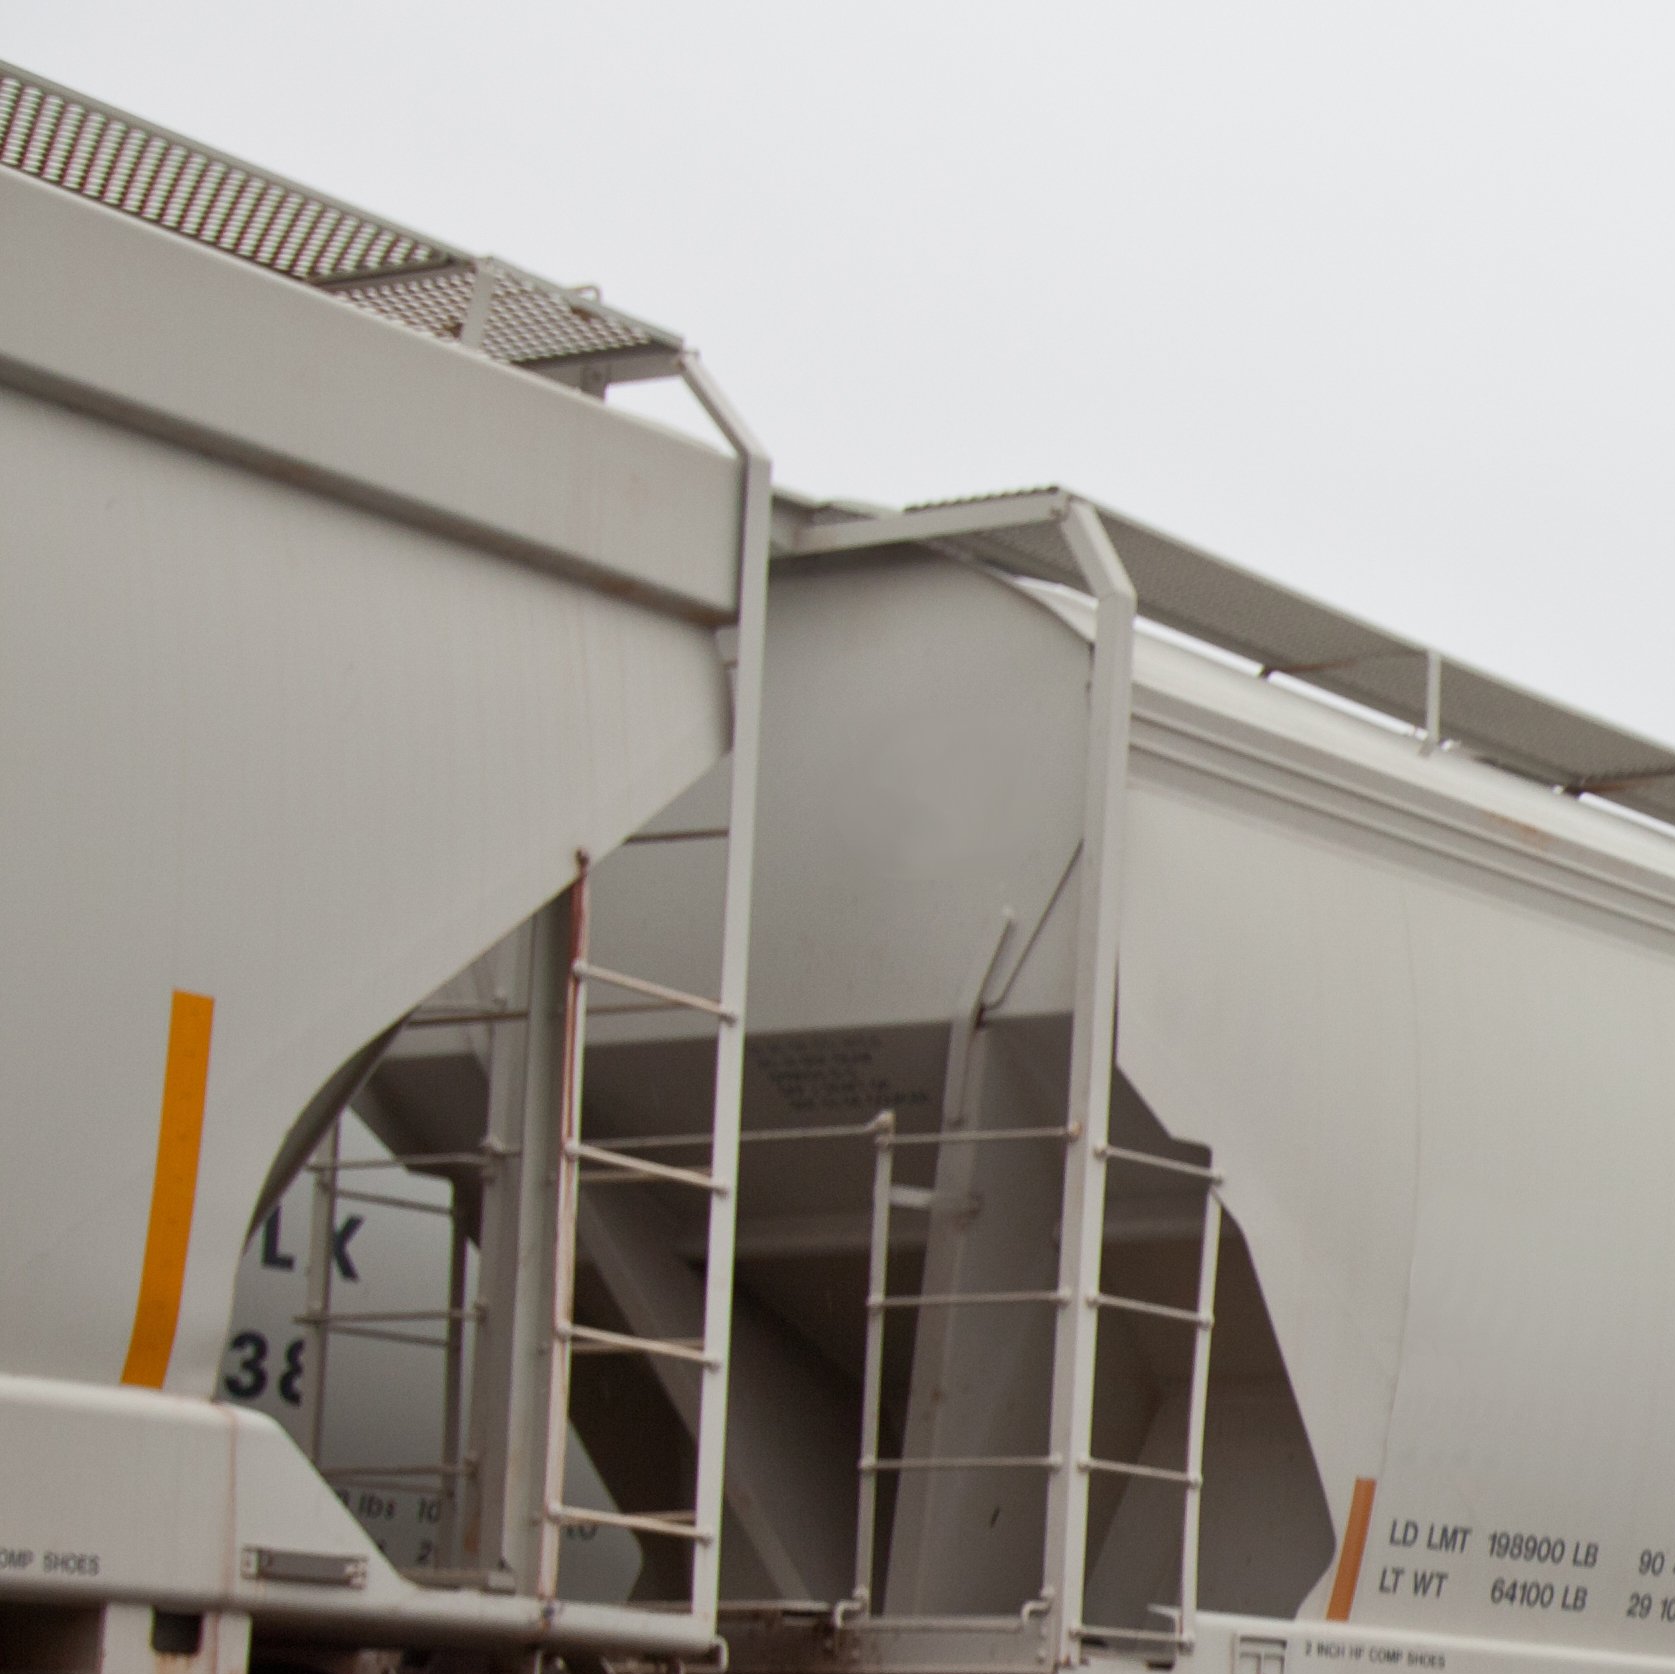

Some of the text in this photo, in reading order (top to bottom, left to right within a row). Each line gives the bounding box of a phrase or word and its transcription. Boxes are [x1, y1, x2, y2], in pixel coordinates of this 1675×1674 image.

[1389, 1518, 1419, 1547] LD
[1426, 1523, 1473, 1554] LMT
[1488, 1529, 1566, 1564] 198900
[1572, 1540, 1600, 1568] LB
[1639, 1548, 1665, 1577] 90
[1379, 1565, 1405, 1594] LT
[1413, 1568, 1449, 1599] WT
[1490, 1576, 1554, 1609] 64100
[1560, 1584, 1588, 1612] LB
[1626, 1591, 1652, 1619] 29
